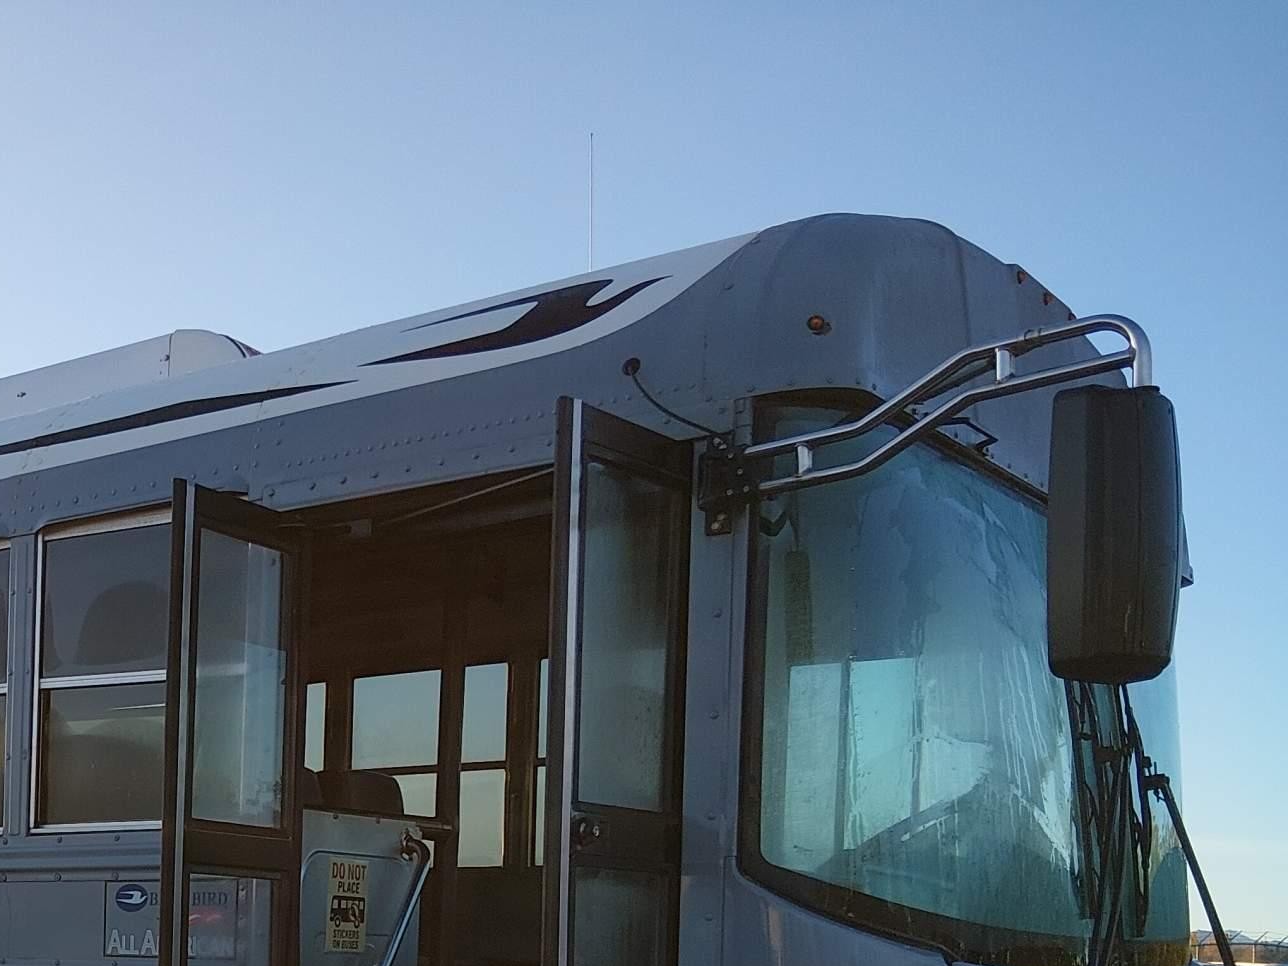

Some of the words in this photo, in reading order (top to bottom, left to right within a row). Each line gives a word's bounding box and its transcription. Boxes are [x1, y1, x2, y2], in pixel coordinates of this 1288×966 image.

[332, 862, 345, 879] DO
[347, 864, 367, 881] NOT
[337, 881, 360, 894] PLACE
[192, 891, 228, 906] BIRD
[333, 929, 360, 940] STICKERS
